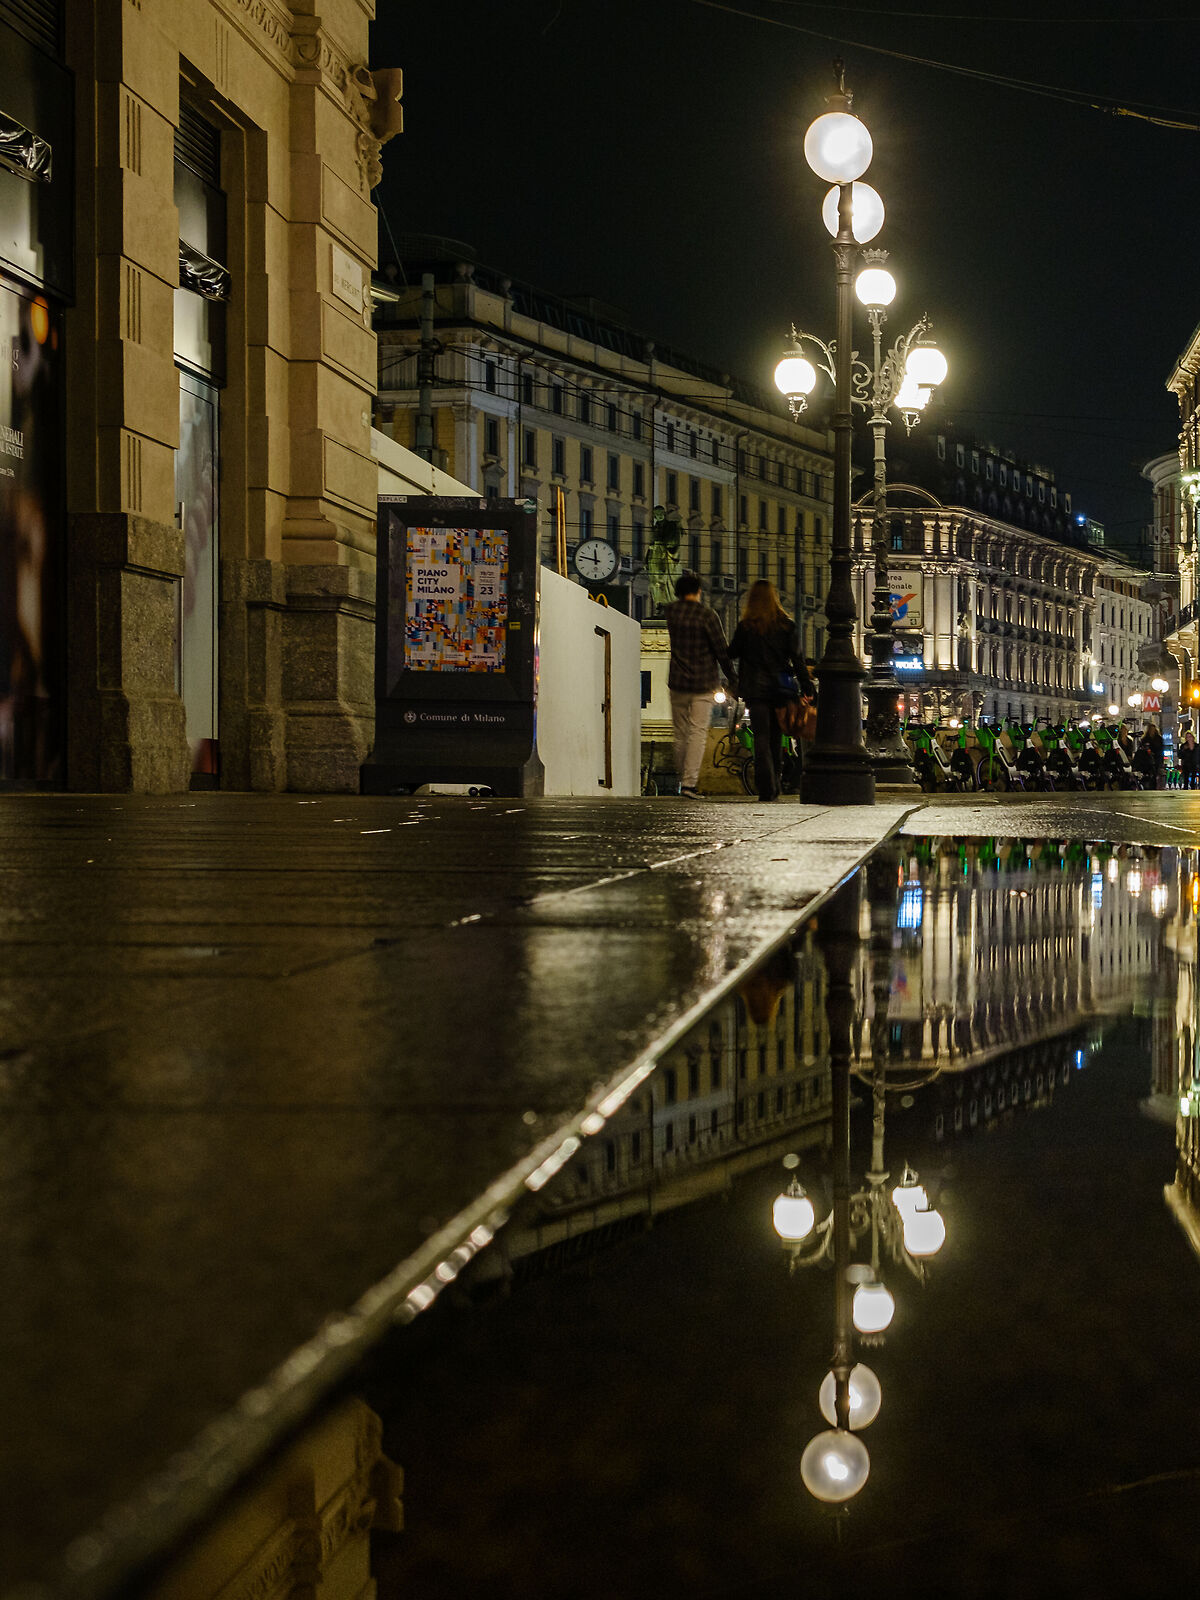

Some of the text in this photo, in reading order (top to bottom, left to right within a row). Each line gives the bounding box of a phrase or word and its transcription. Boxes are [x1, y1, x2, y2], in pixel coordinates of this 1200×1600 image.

[418, 569, 448, 577] PIANO
[417, 577, 439, 585] CITY
[417, 586, 455, 594] MILANO
[480, 586, 494, 595] 23
[1144, 695, 1161, 709] M
[420, 713, 505, 722] Comune di Milano
